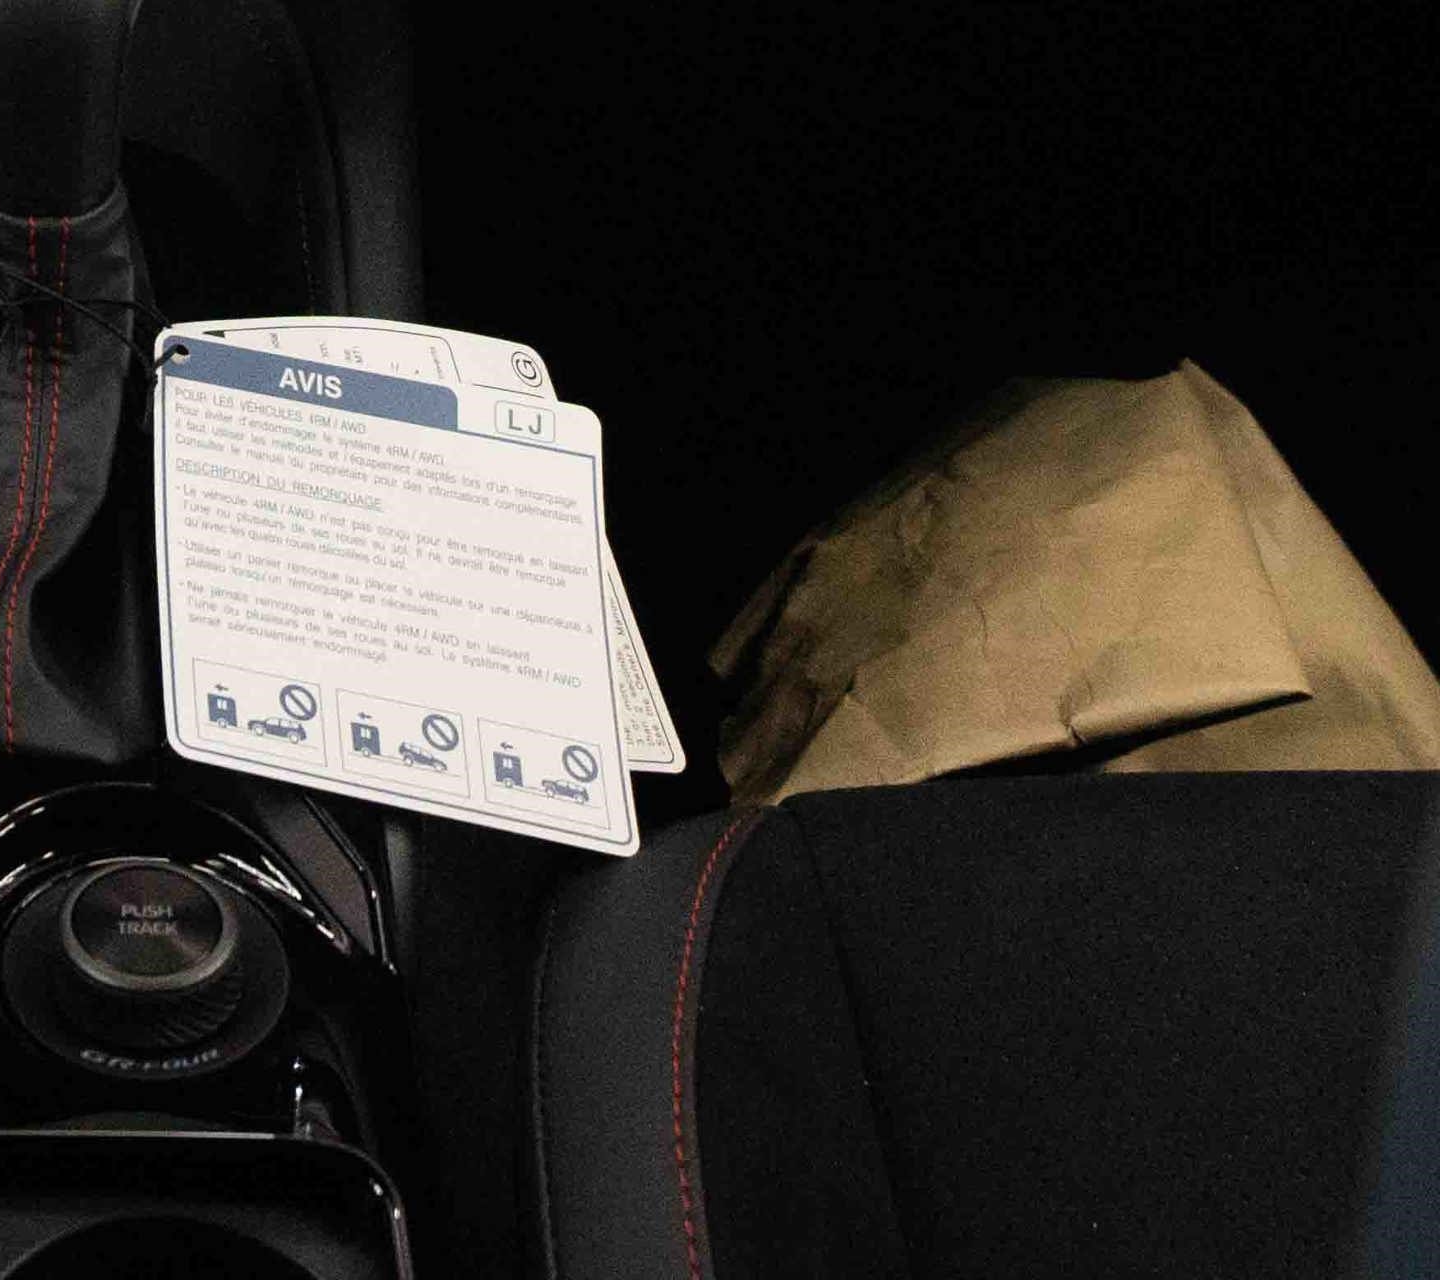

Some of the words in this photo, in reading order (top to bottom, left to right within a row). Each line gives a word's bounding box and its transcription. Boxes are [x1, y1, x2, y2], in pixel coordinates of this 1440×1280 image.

[278, 367, 343, 400] AVIS
[175, 386, 207, 402] POUR
[212, 394, 234, 409] LES
[341, 418, 368, 434] AWD
[385, 445, 410, 460] 4RM
[175, 456, 260, 485] DESCRIPTION
[266, 474, 286, 490] DU
[292, 480, 383, 508] REMORQUAGE
[288, 504, 316, 521] AWD
[416, 531, 440, 547] pour
[119, 904, 175, 919] PUSH
[117, 920, 179, 937] TRACK
